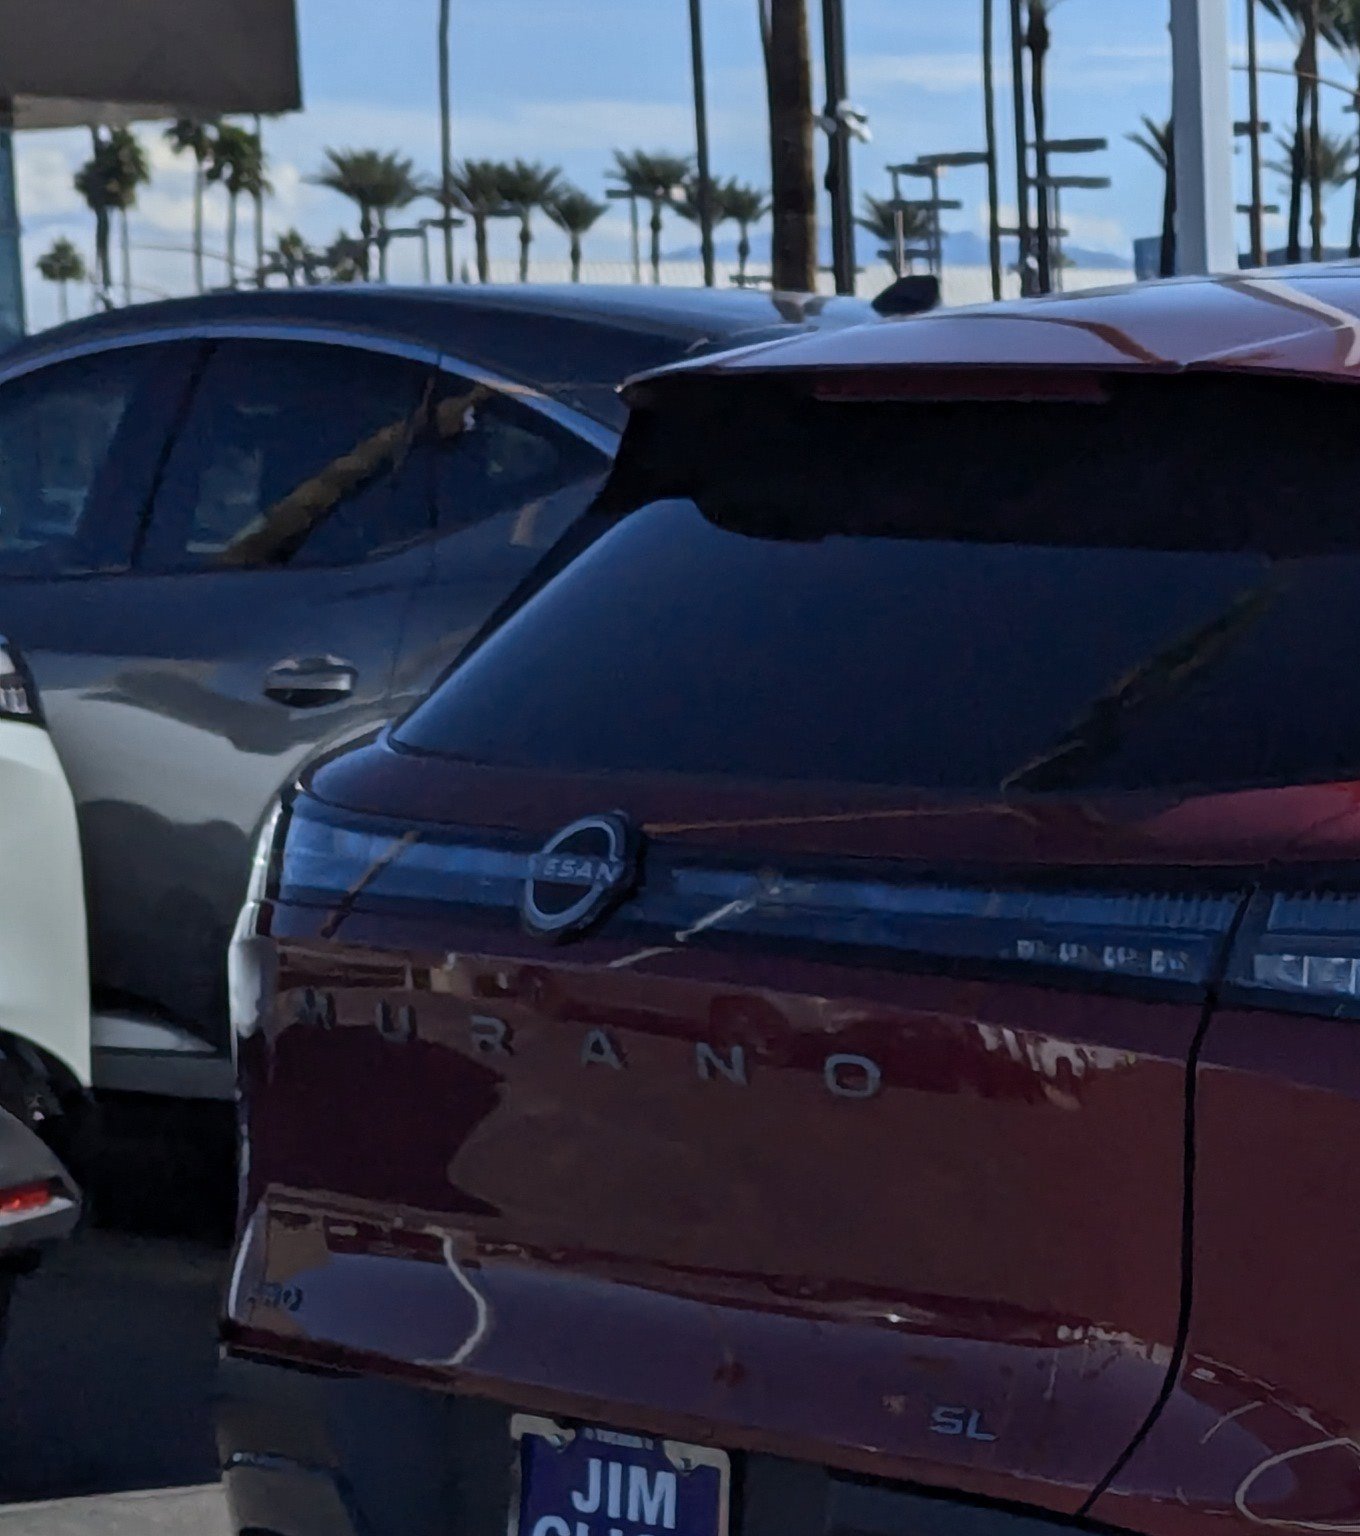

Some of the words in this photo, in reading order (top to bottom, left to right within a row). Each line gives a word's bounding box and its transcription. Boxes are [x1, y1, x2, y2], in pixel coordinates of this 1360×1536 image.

[528, 851, 616, 883] SSAN
[301, 986, 884, 1100] MURANO
[928, 1405, 999, 1442] SL
[570, 1457, 677, 1530] JIM
